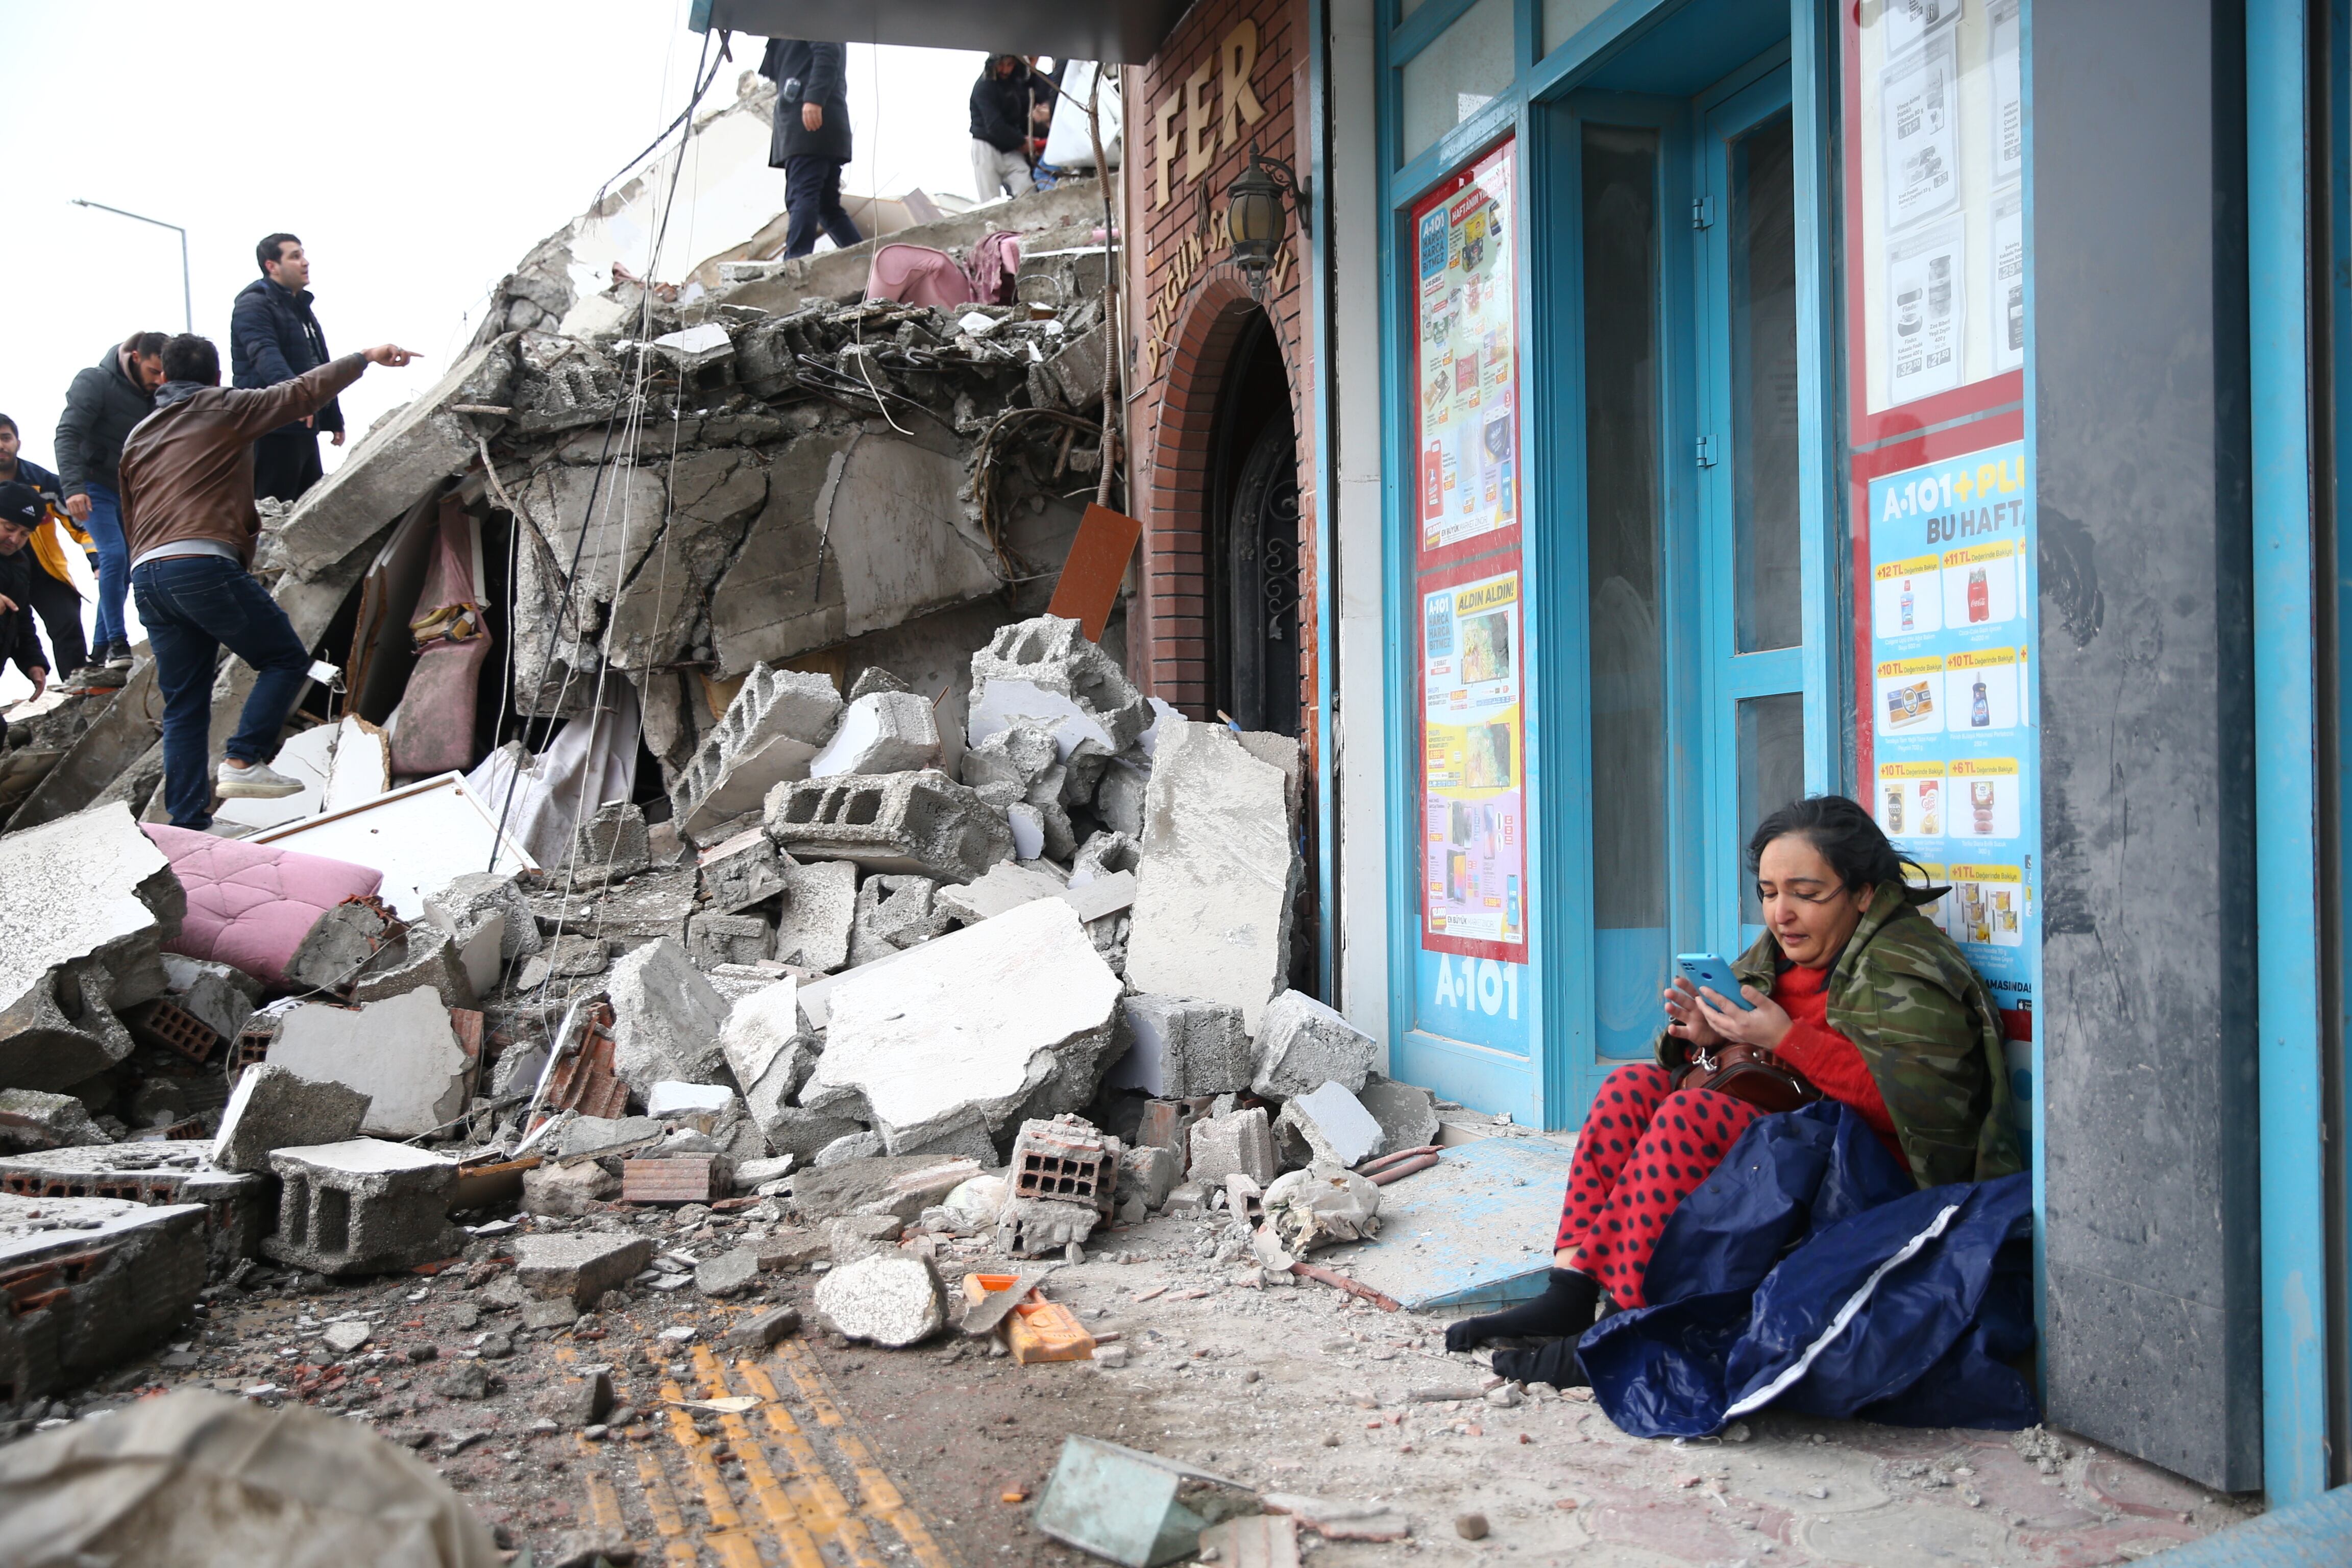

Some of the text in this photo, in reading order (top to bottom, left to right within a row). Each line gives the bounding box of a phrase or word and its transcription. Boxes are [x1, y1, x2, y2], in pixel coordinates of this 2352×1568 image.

[1156, 18, 1268, 212] FER
[2004, 115, 2017, 126] Çocuk
[2004, 123, 2018, 133] Devam
[2004, 131, 2015, 140] Sütü
[2004, 138, 2014, 147] 200
[1452, 193, 1479, 223] HAFTANIN
[1423, 228, 1444, 250] HARCA
[1423, 240, 1444, 261] HARCA
[1147, 231, 1205, 378] DÜĞÜN
[1927, 499, 2025, 545] BU HAFT
[1446, 524, 1459, 535] BÜYÜK
[1959, 551, 1971, 563] TL
[1971, 551, 1995, 562] Değerinde
[1996, 549, 2013, 557] Bakiye
[1892, 564, 1903, 576] TL
[1904, 566, 1923, 574] Değerinde
[1458, 580, 1515, 611] ALDIN ALDIN!
[1429, 614, 1449, 627] HARCA
[1429, 626, 1450, 640] HARCA
[1429, 638, 1451, 651] BİTMEZ
[1963, 653, 1974, 666] TL
[1974, 656, 1997, 666] Değerinde
[1892, 663, 1903, 674] TL
[1904, 666, 1926, 674] Değerinde
[1895, 764, 1905, 775] TL
[1965, 761, 1976, 773] TL
[1976, 766, 1998, 774] Değerinde
[1998, 766, 2013, 774] Bakiye
[1952, 866, 2017, 881] +1 TL Değerinde Bakiye
[1453, 915, 1467, 924] BÜYÜK
[1985, 978, 2031, 994] AMASINDA!
